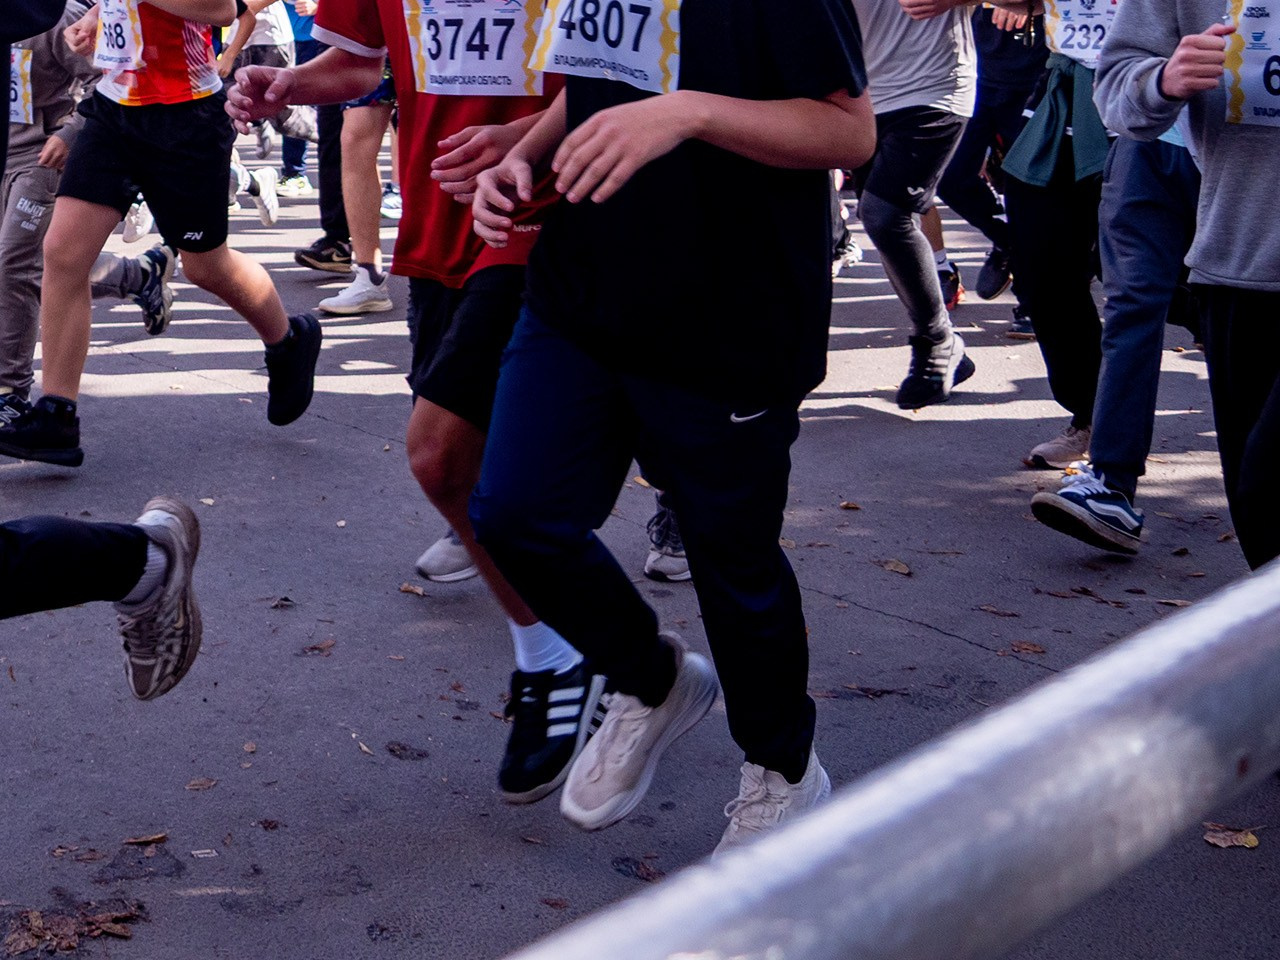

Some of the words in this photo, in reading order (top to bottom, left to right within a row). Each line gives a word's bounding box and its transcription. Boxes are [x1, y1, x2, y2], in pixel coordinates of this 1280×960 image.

[427, 17, 516, 62] 3747
[1060, 23, 1110, 50] 232
[478, 74, 512, 86] ОБЛАСТЬ
[183, 231, 203, 240] FN
